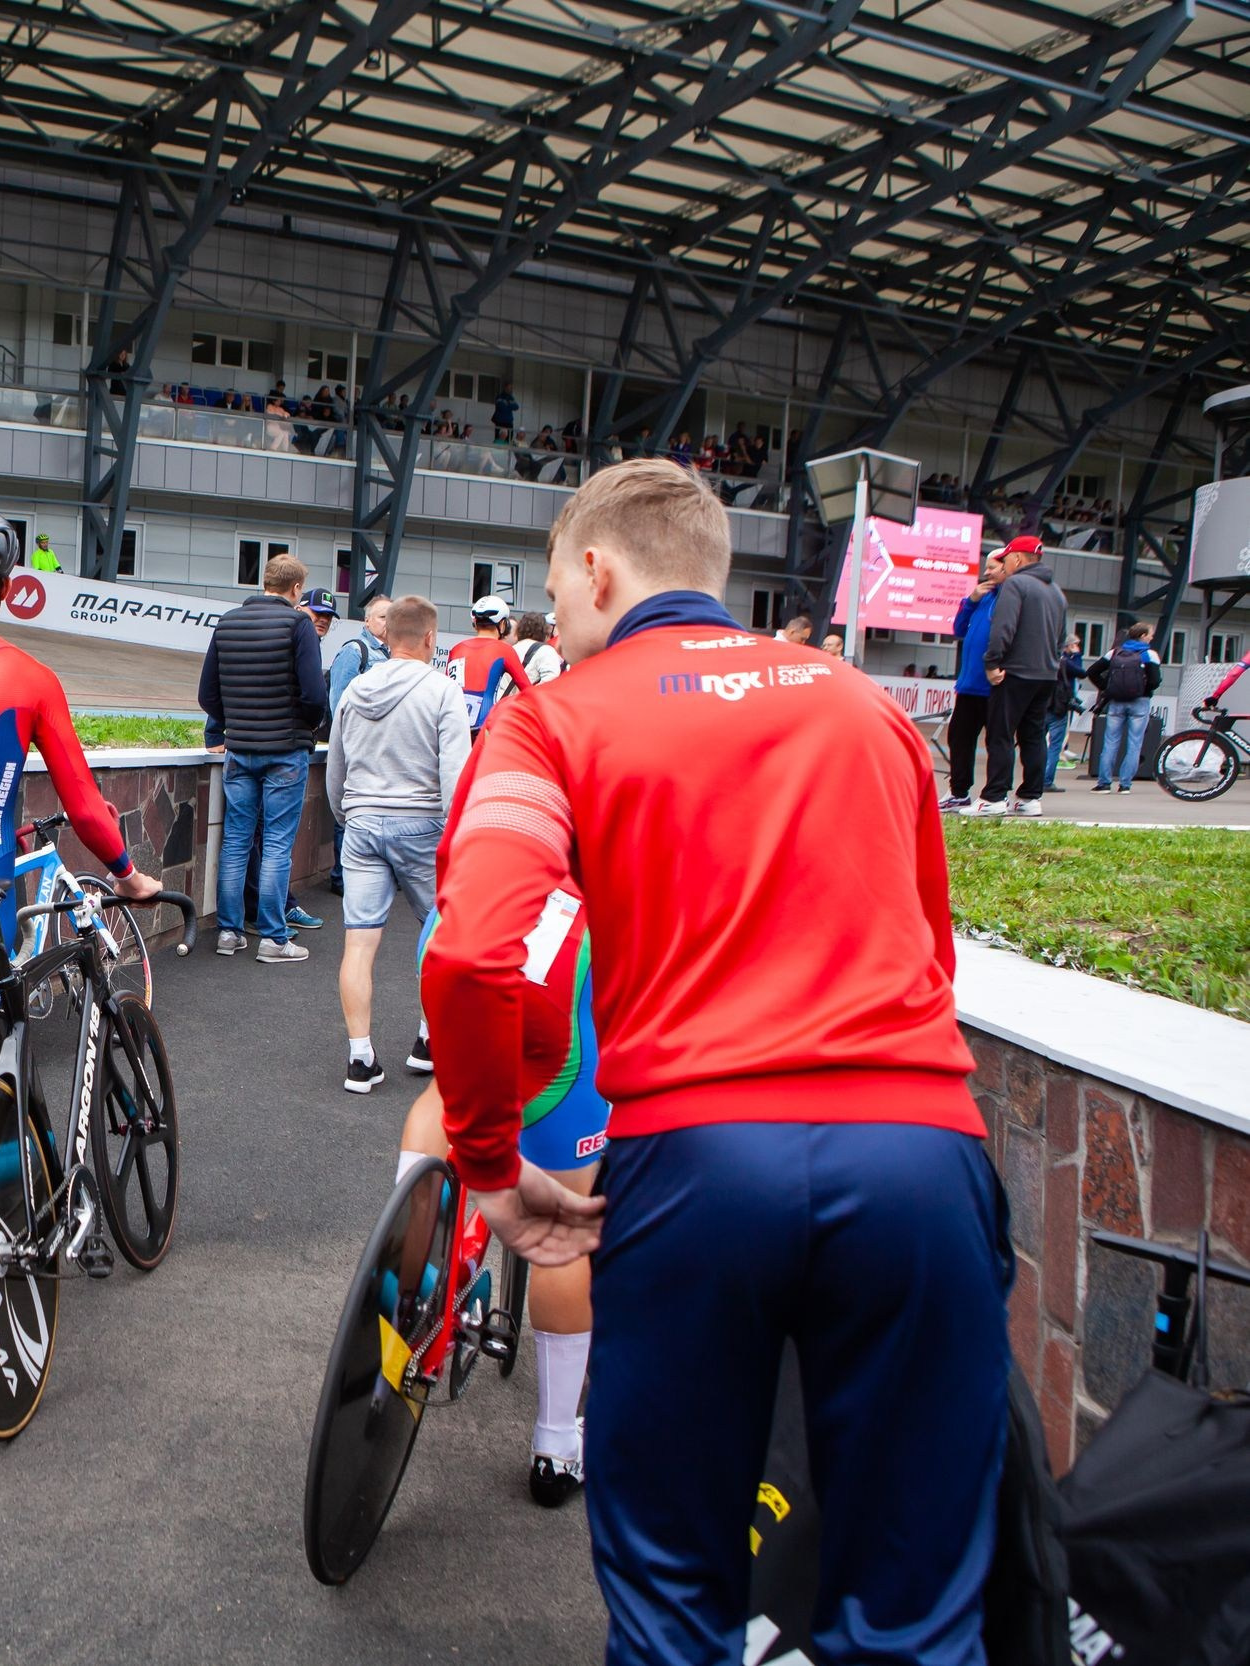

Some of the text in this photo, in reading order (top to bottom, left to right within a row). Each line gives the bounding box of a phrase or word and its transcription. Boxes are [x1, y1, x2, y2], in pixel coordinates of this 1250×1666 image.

[70, 610, 118, 624] GROUP
[680, 635, 758, 650] Santic
[778, 667, 832, 677] CYCLING
[660, 671, 764, 701] minsk
[779, 675, 814, 685] CLUB
[76, 1001, 101, 1166] ARGON 18
